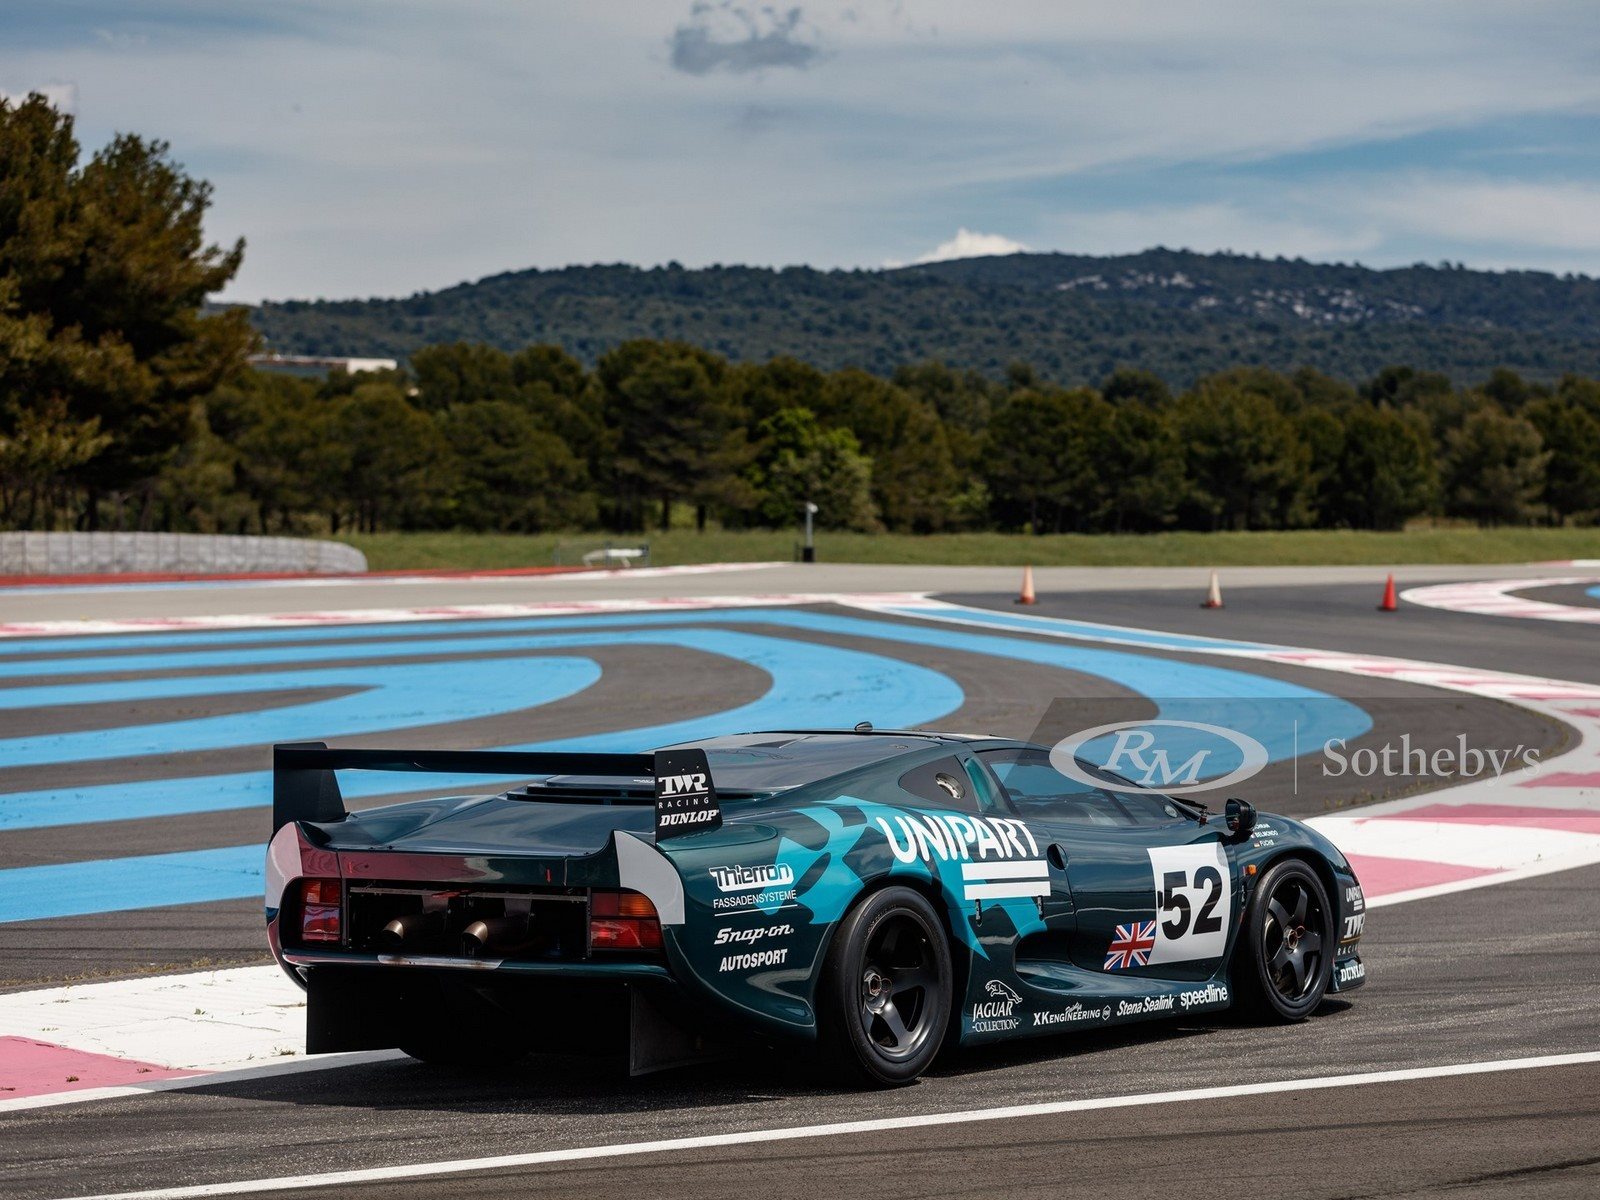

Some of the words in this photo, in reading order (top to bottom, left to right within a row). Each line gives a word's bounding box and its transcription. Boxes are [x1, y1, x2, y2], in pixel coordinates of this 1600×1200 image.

[658, 773, 709, 795] TWR
[658, 797, 709, 809] RACING
[659, 809, 720, 826] DUNLOP
[876, 816, 1039, 863] UNIPART
[709, 863, 794, 892] Thierron
[713, 890, 797, 909] FASSADENSYSTEME
[1161, 866, 1223, 940] 52
[714, 924, 792, 945] Snap-on
[719, 949, 788, 972] AUTOSPORT
[1116, 1000, 1143, 1016] Stena
[1143, 994, 1175, 1013] Sealink
[1180, 984, 1228, 1010] speedline
[973, 1001, 1014, 1022] JAGUAR
